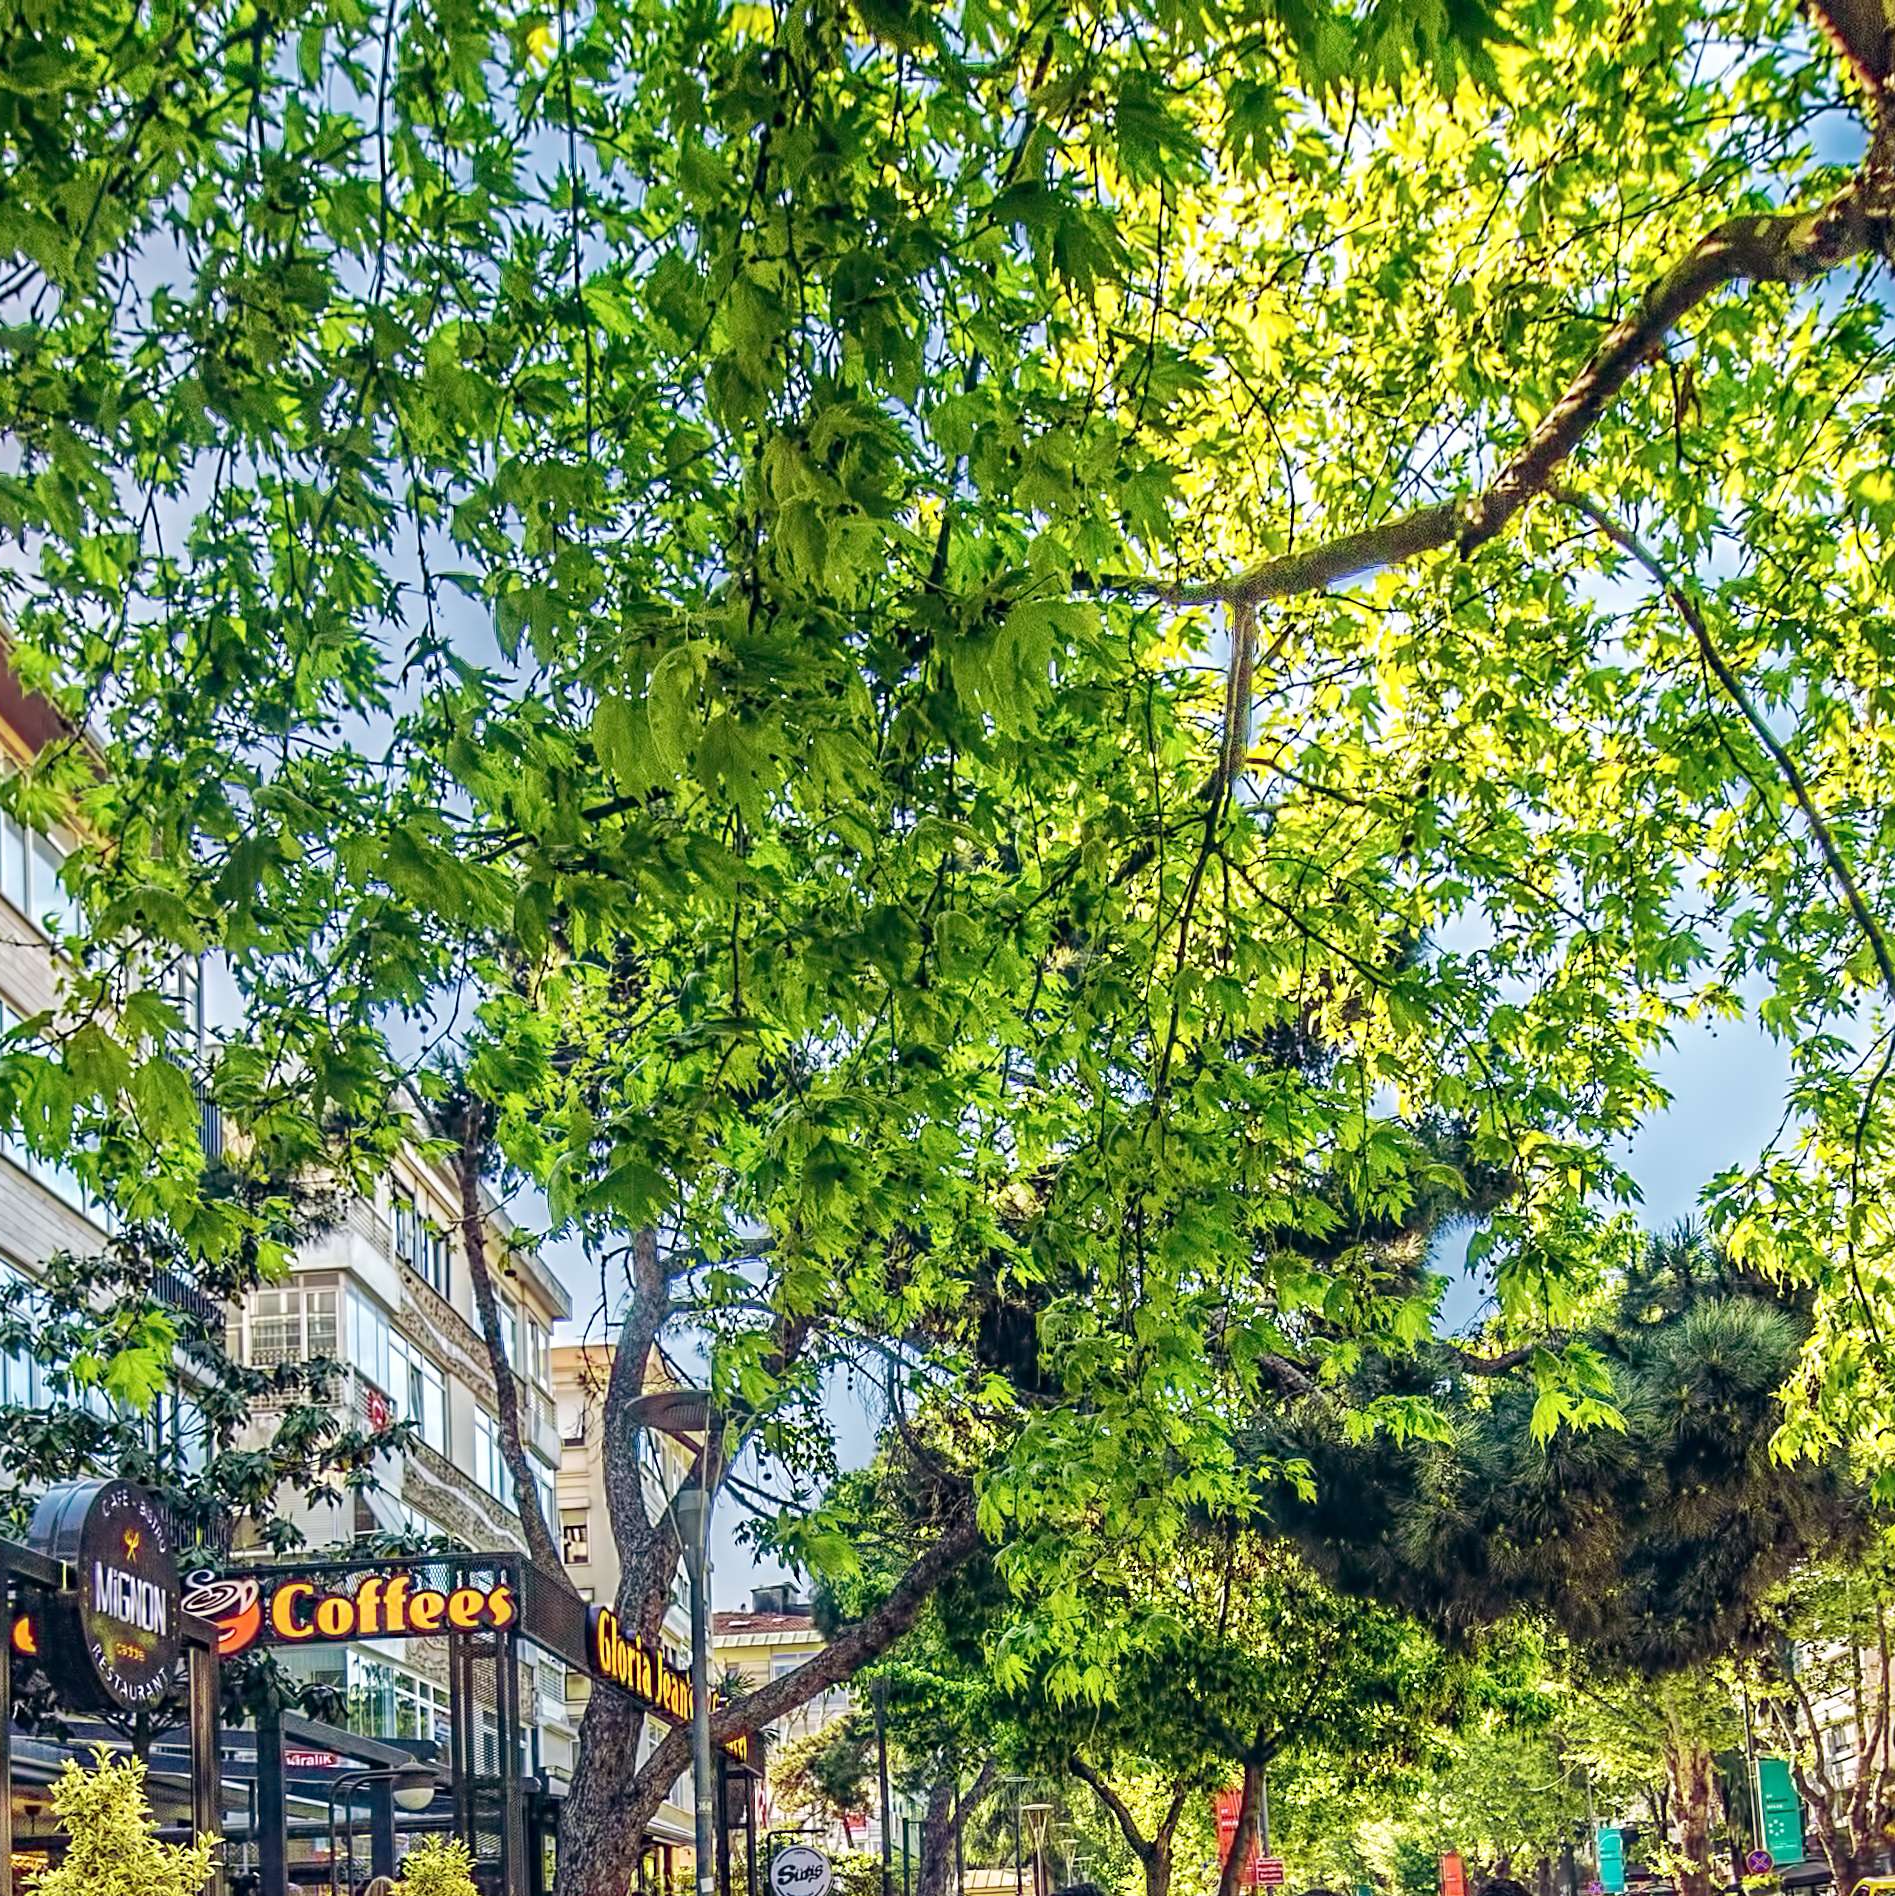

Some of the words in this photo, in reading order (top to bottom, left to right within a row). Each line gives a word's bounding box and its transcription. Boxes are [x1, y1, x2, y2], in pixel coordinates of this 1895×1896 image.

[101, 1488, 129, 1518] CAFE
[271, 1576, 513, 1638] Coffees
[91, 1642, 168, 1702] RESTAURANT
[597, 1608, 653, 1700] Gloria
